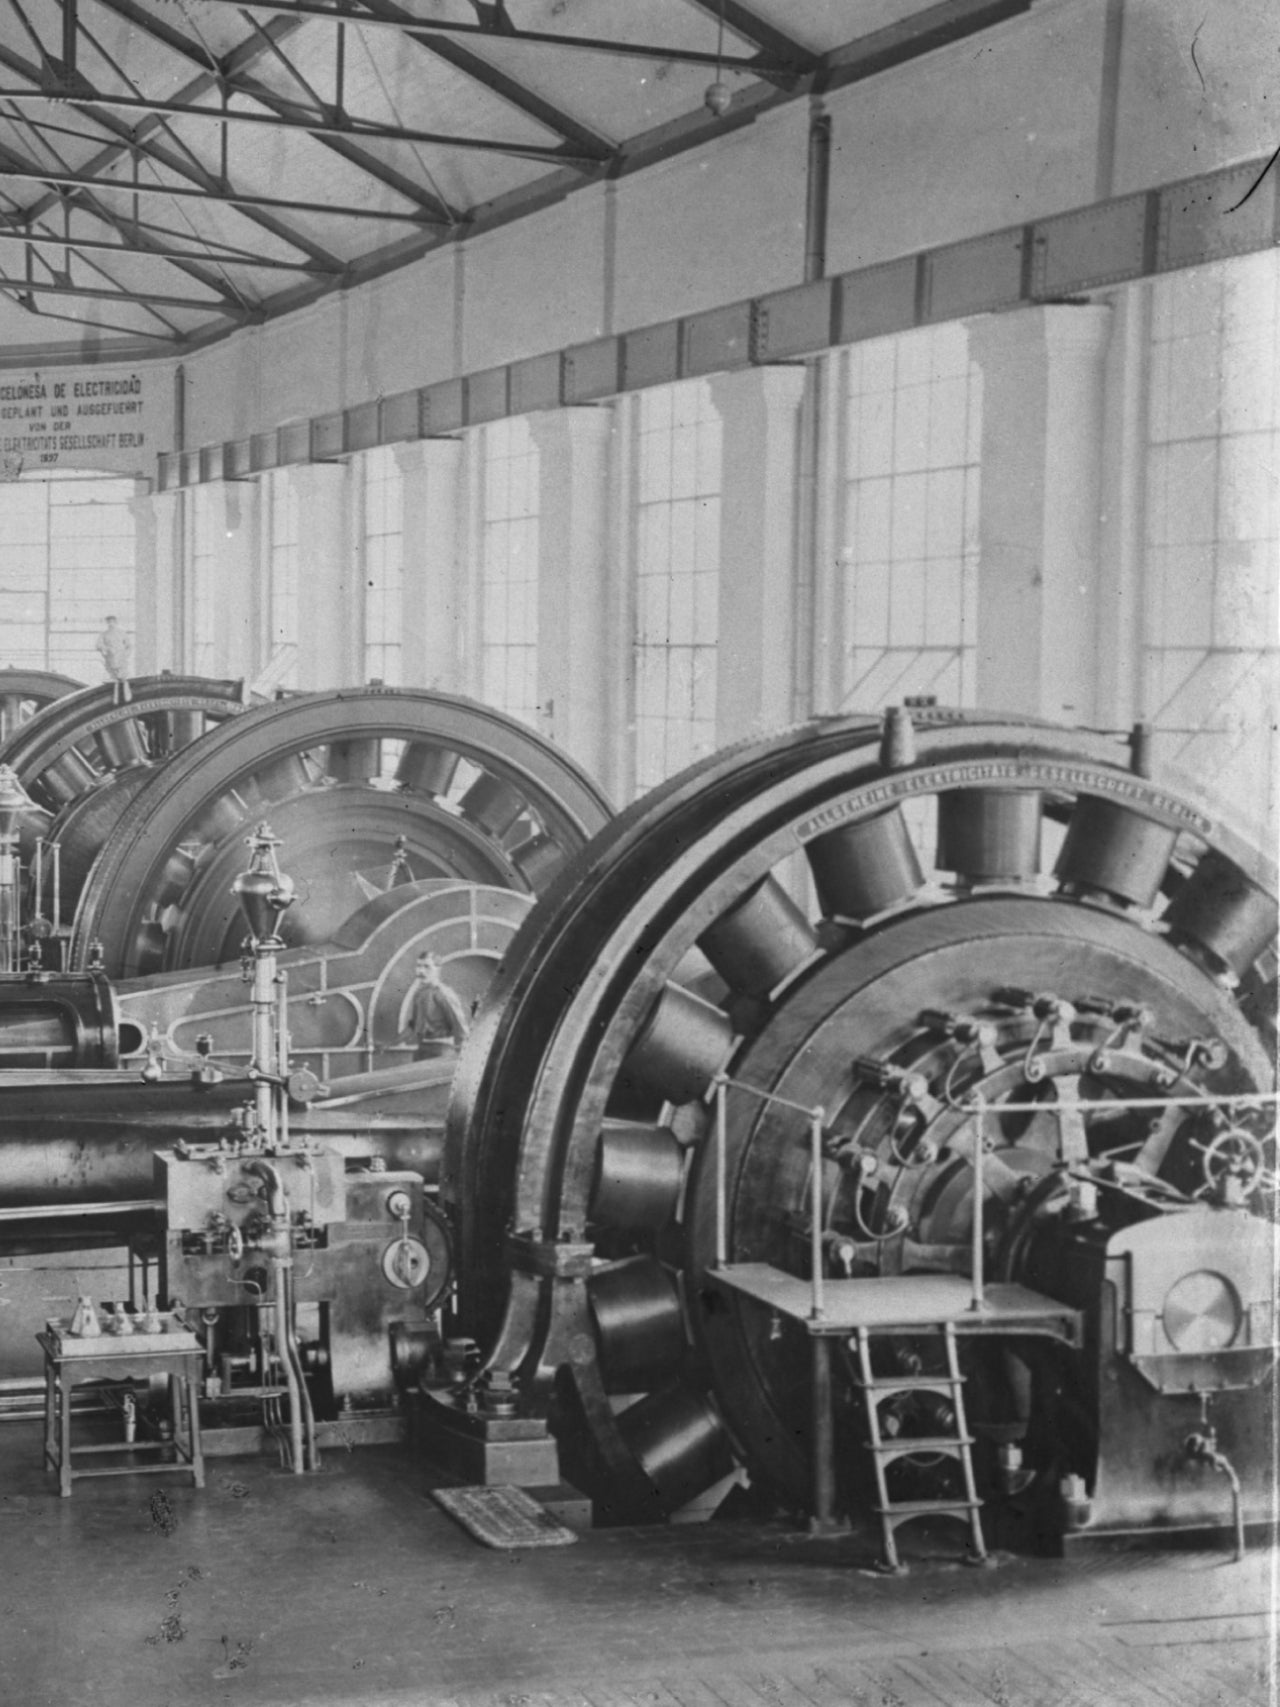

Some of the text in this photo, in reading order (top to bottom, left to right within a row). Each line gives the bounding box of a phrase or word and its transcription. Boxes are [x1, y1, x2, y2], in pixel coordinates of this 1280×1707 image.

[54, 383, 66, 399] DE
[73, 379, 142, 398] ELECTRICIDAD
[1, 406, 43, 419] GEPLANT
[50, 405, 69, 417] UND
[77, 401, 144, 416] AUSGEFUEHRT
[29, 421, 72, 432] VON DER
[59, 433, 116, 450] GESELLSCHAFT
[118, 433, 144, 448] BERLIN
